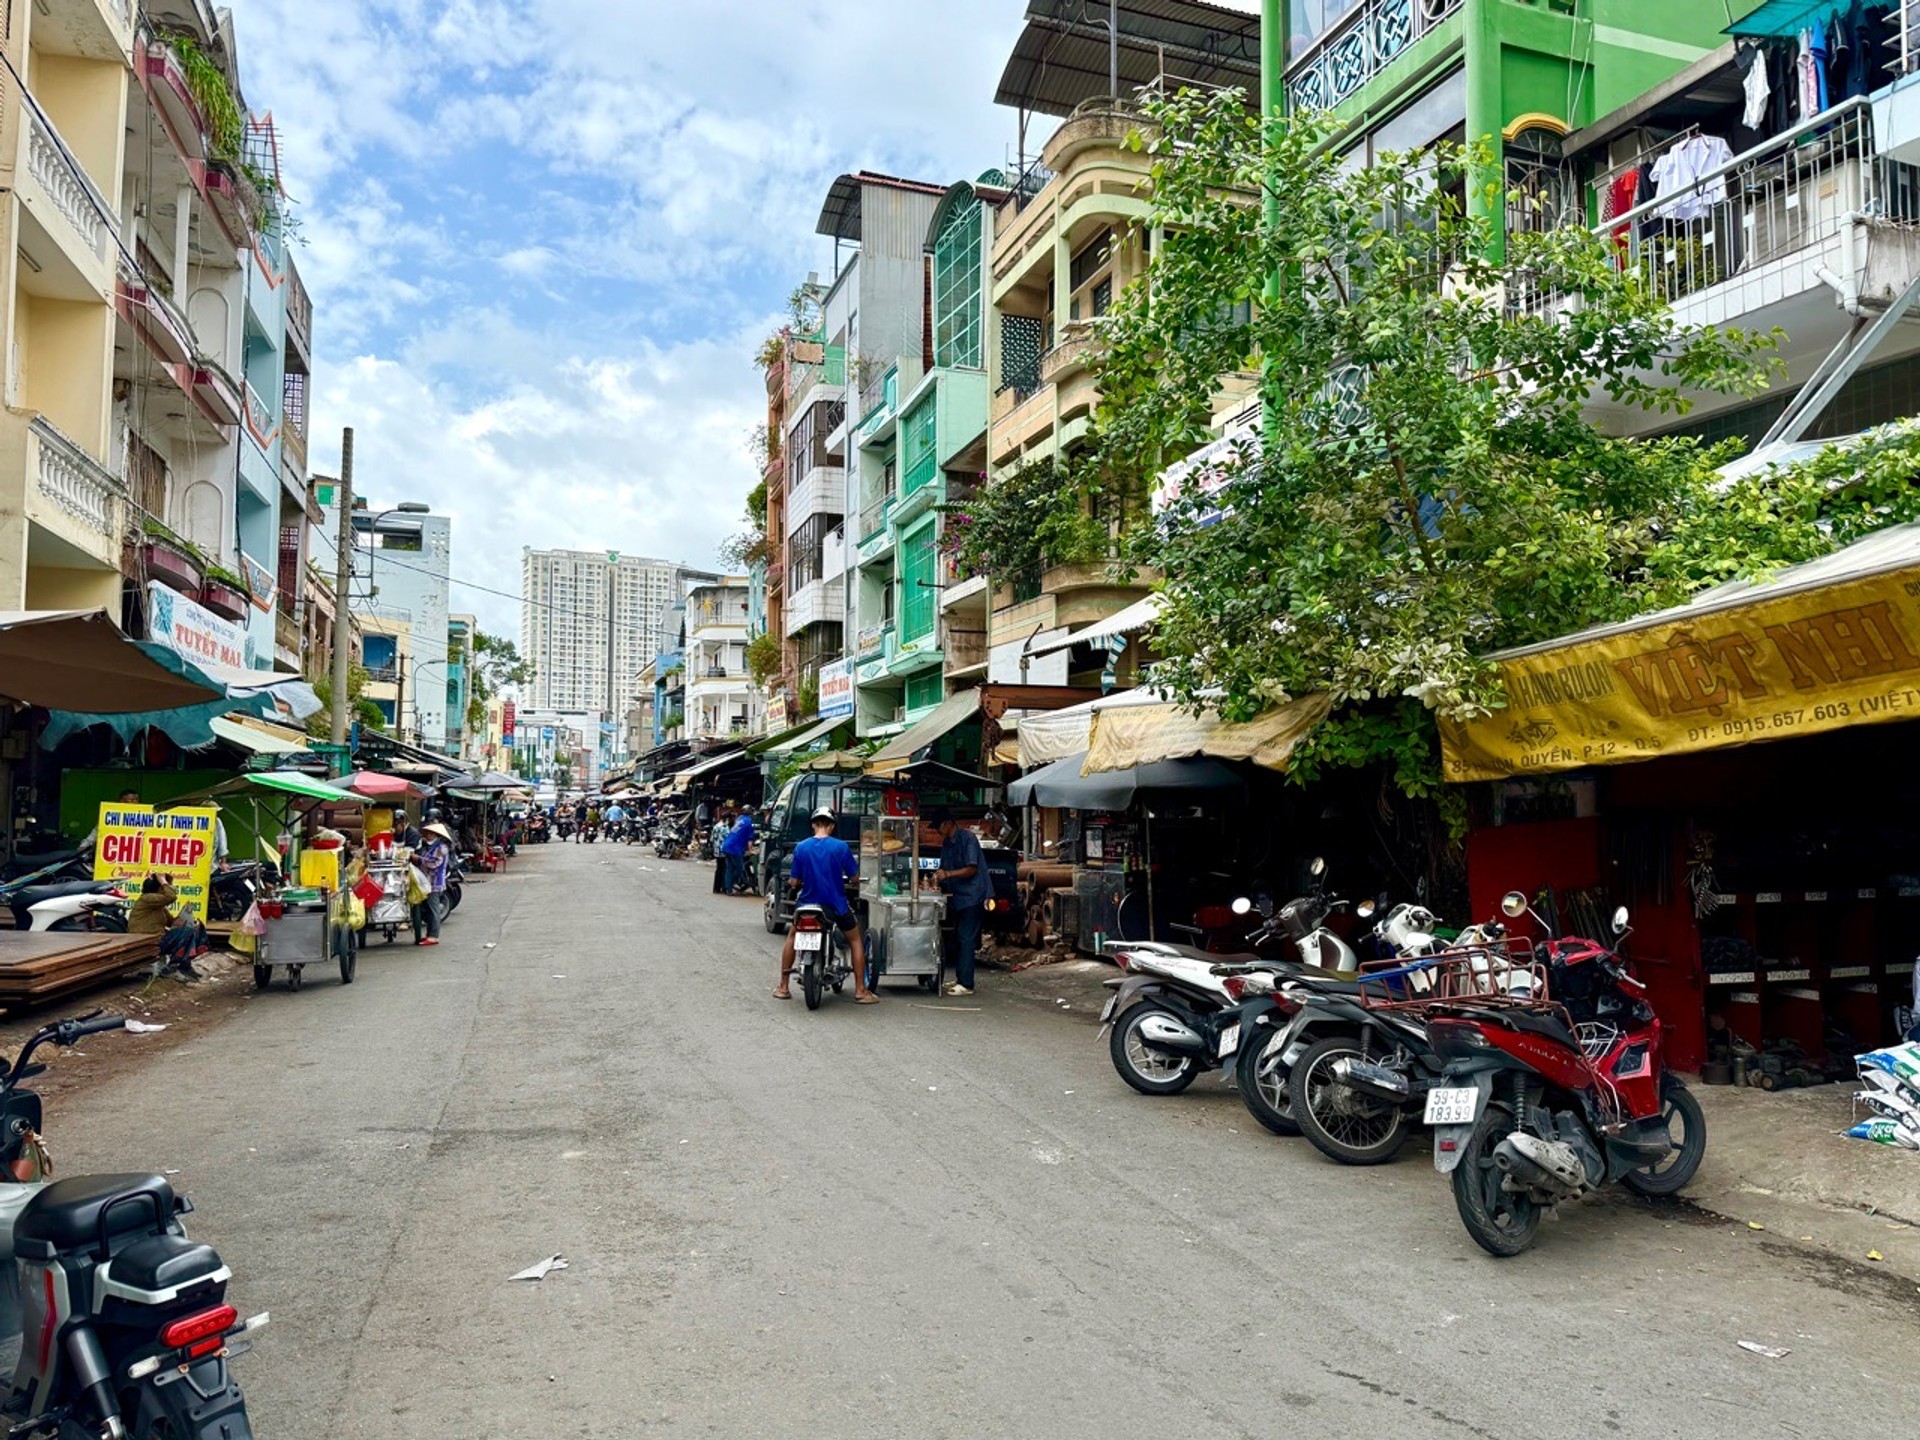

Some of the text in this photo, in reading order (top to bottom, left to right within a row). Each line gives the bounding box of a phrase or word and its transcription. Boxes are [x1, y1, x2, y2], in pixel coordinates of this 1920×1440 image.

[221, 645, 241, 669] MAI
[1613, 631, 1768, 717] VIỆT
[1763, 600, 1920, 690] NHI
[1557, 659, 1615, 701] BULON
[1723, 702, 1851, 736] 0915.657.603
[1583, 742, 1616, 760] P.12
[105, 810, 210, 830] CHI NHÁNH CT TNHH TM
[102, 831, 146, 863] CHÍ
[1433, 1089, 1470, 1105] 59-C3
[1429, 1106, 1471, 1122] 183.99
